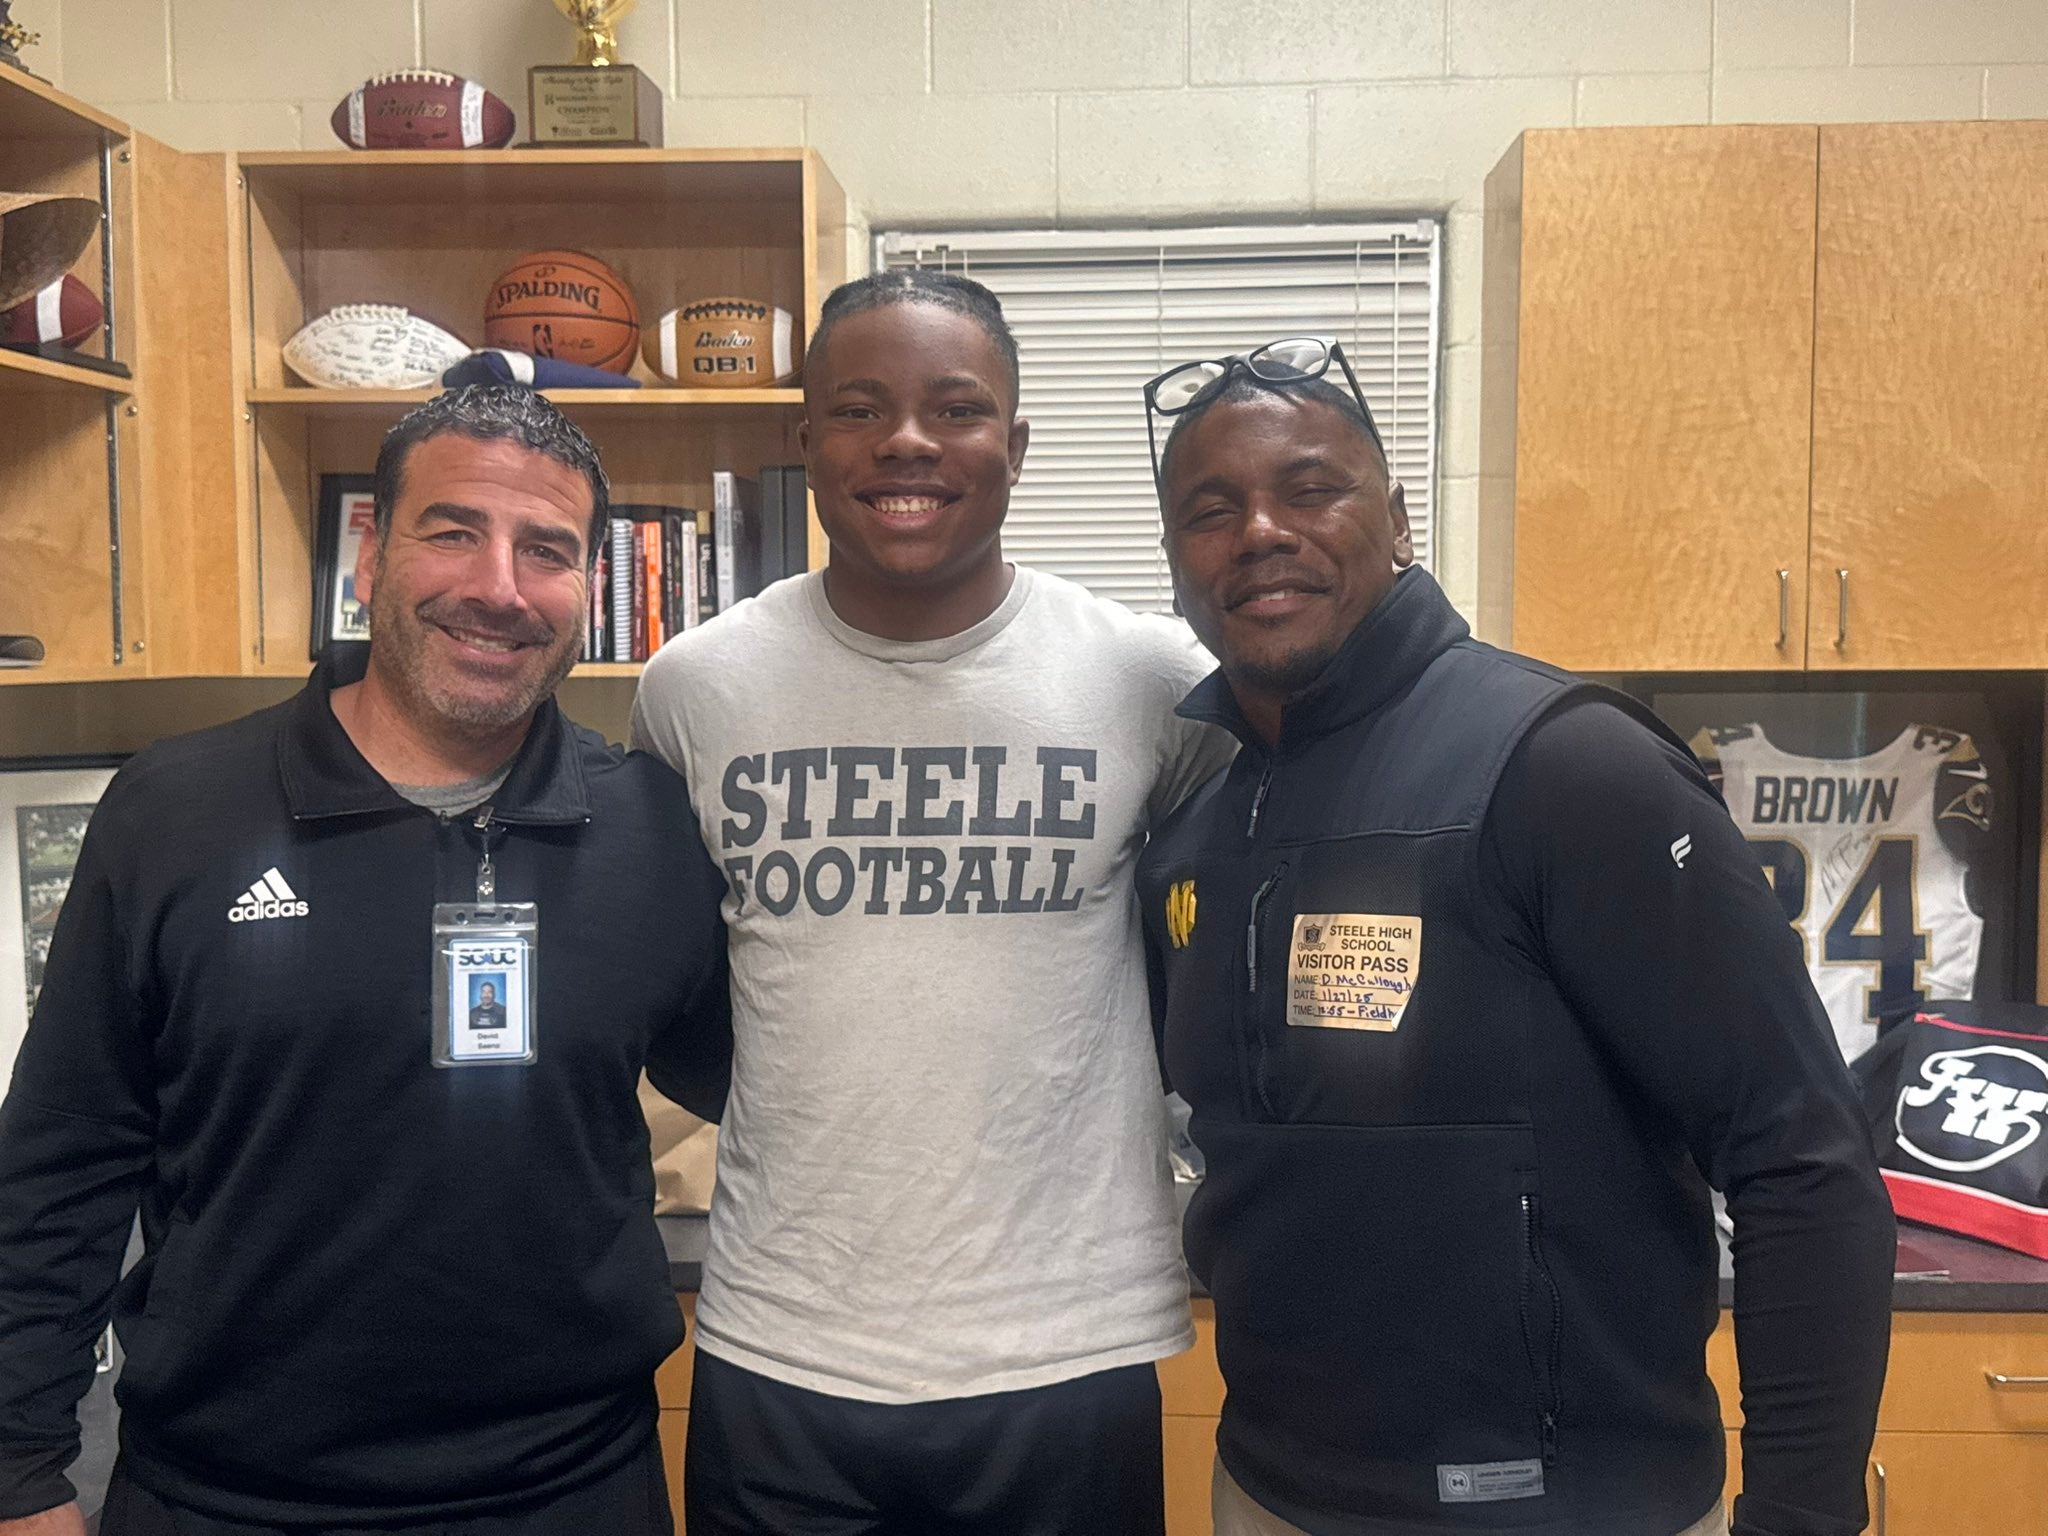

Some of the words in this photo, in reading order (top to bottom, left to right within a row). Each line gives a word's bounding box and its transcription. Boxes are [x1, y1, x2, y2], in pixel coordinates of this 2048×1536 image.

[497, 280, 600, 310] SPALDING
[695, 330, 754, 348] Baden
[721, 746, 1097, 849] STEELE
[1752, 776, 1899, 824] BROWN
[722, 846, 1084, 917] FOOTBALL
[228, 899, 309, 922] adidas
[1329, 925, 1375, 937] STEELE
[1378, 927, 1412, 939] HIGH
[1341, 938, 1395, 952] SCHOOL
[1297, 954, 1355, 970] VISITOR
[1360, 956, 1408, 973] PASS
